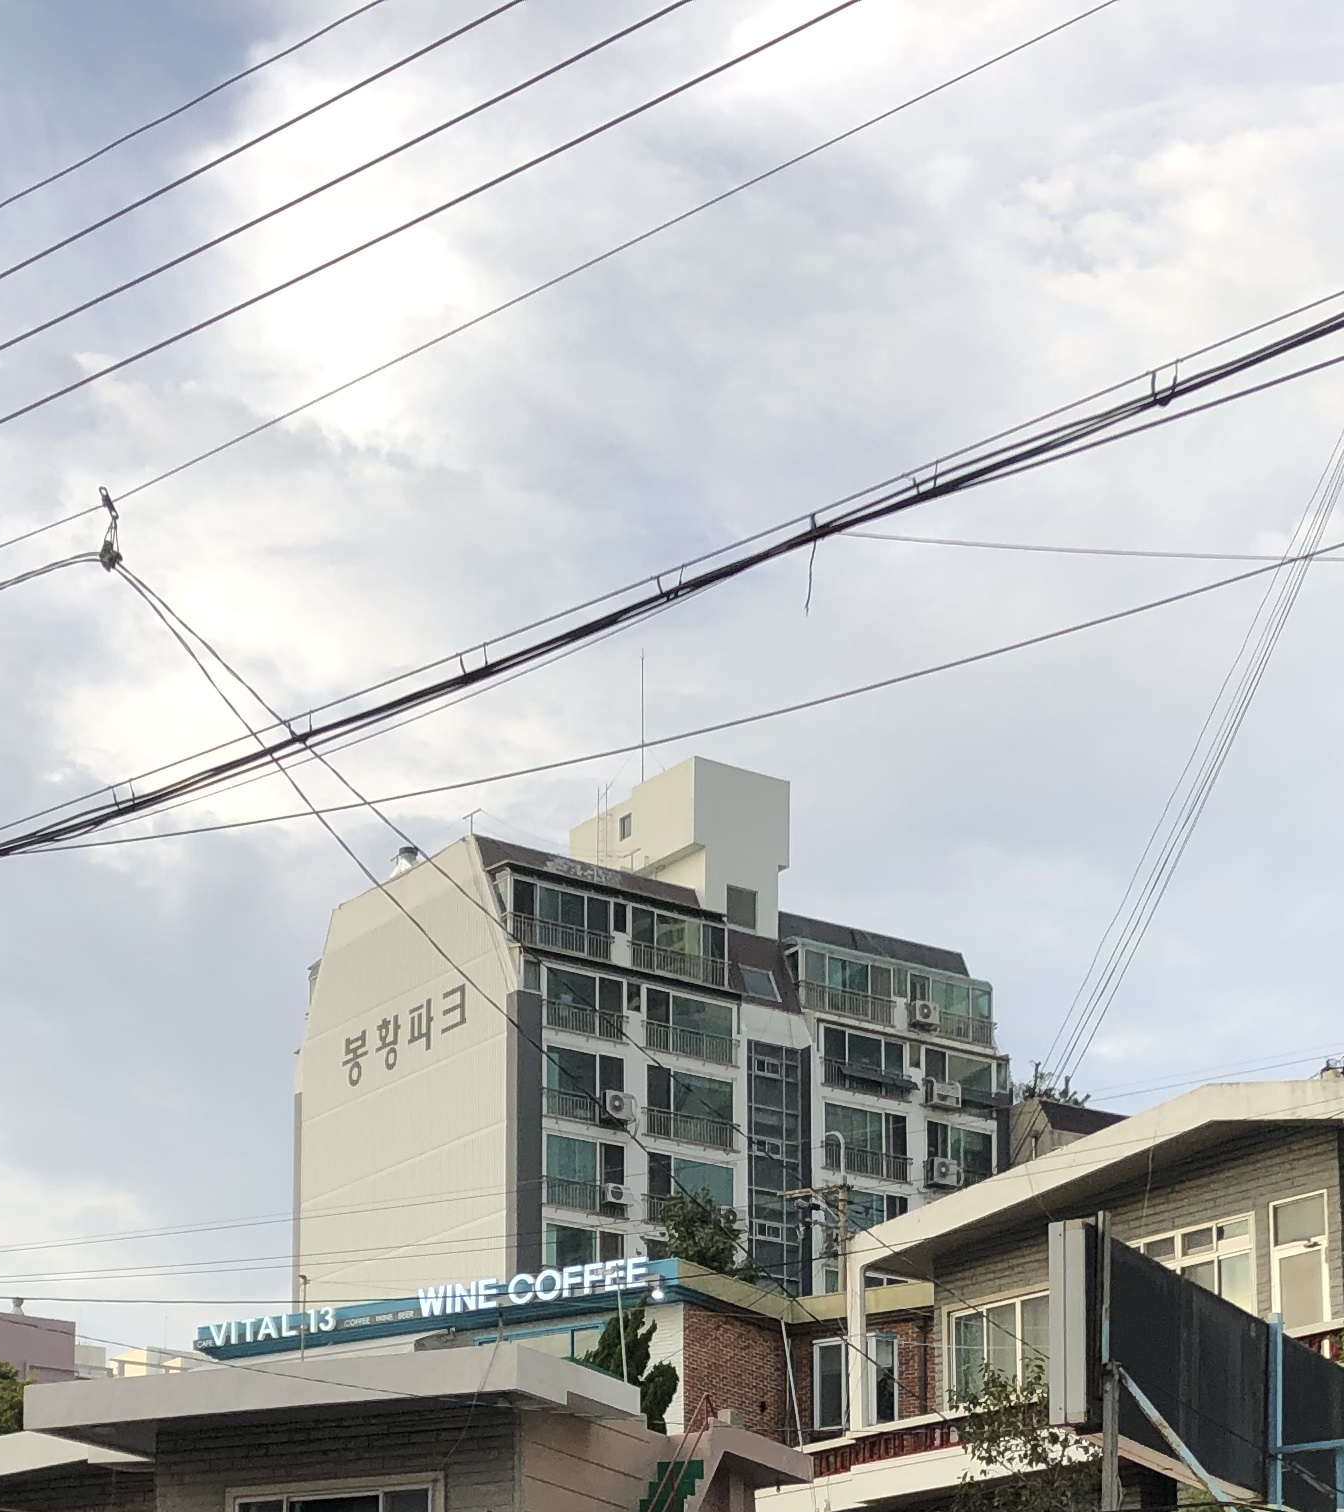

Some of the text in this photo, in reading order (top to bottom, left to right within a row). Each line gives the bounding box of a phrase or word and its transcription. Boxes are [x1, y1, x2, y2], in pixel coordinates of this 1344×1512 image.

[342, 983, 467, 1087] 봉황파크
[417, 1255, 649, 1318] WINE COFFEE
[209, 1313, 299, 1347] VITAL
[343, 1316, 370, 1328] COFFEE
[375, 1312, 393, 1322] WINE
